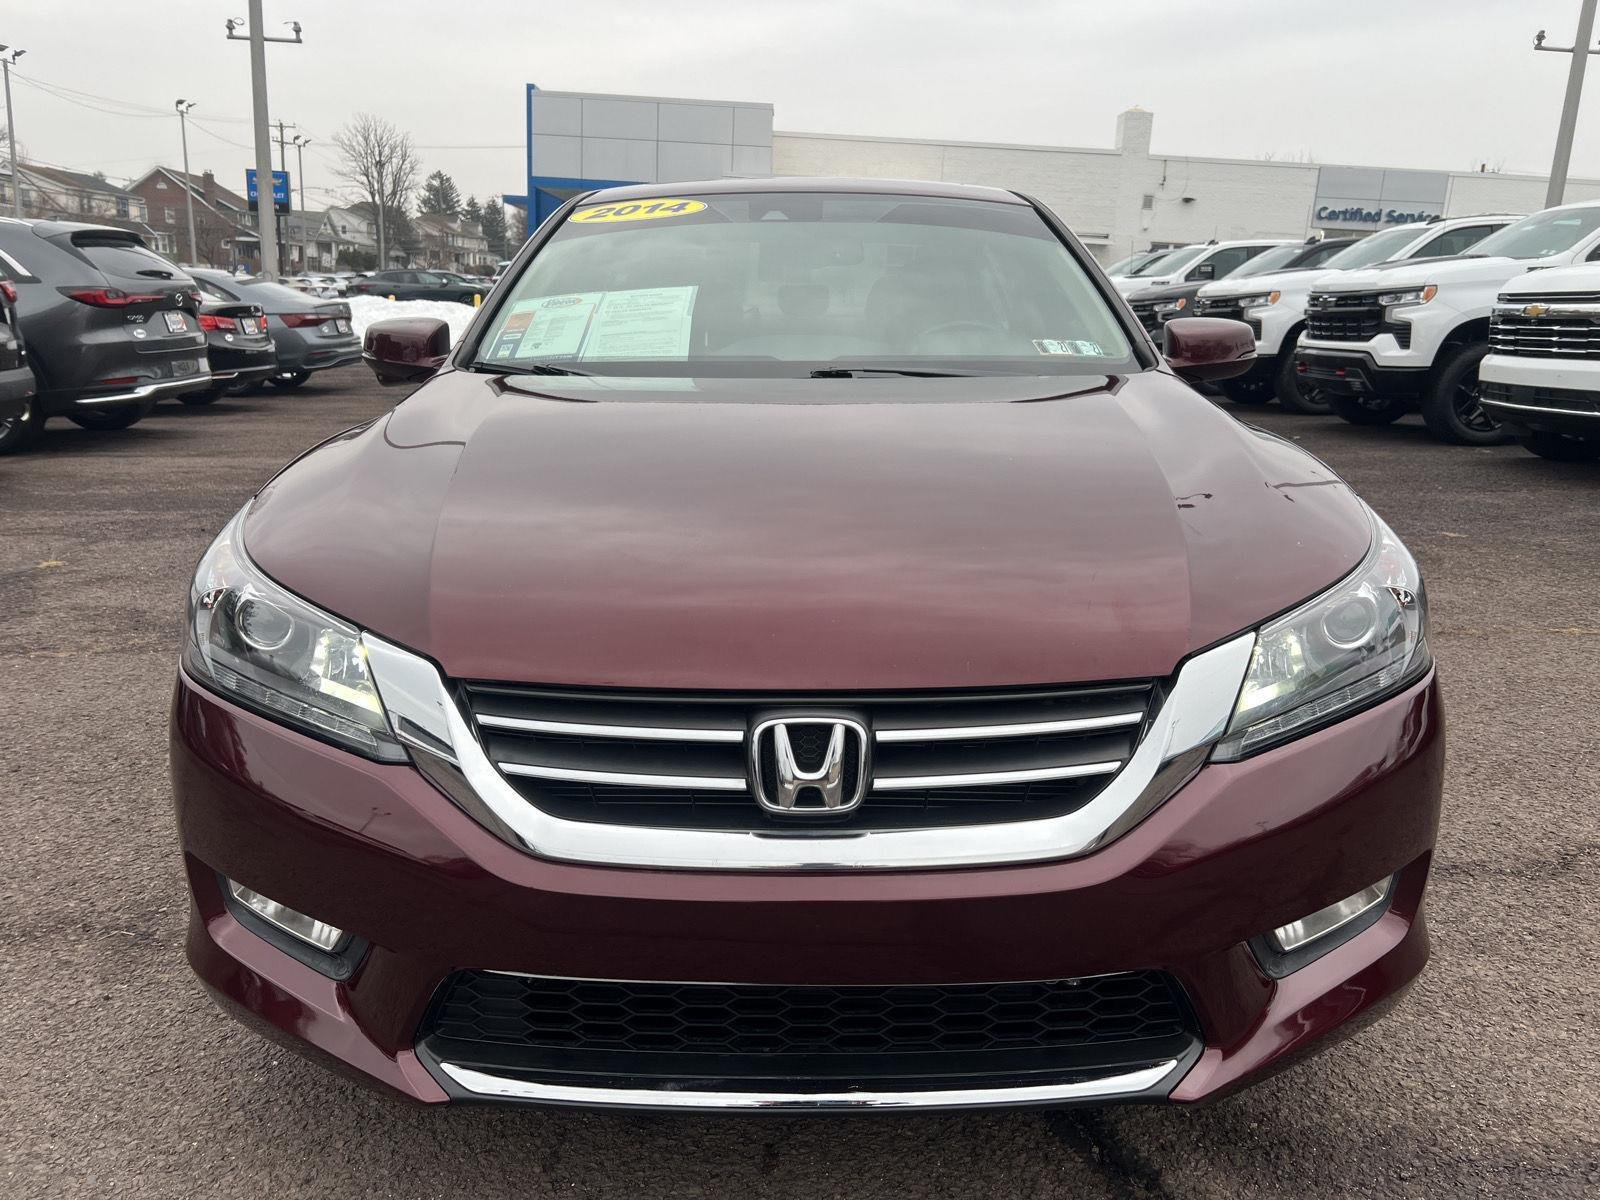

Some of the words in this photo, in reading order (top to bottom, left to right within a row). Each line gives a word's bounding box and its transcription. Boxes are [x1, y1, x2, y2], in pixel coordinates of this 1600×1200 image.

[250, 191, 284, 199] CHLET
[582, 202, 690, 220] 2014
[1316, 206, 1382, 223] Certified
